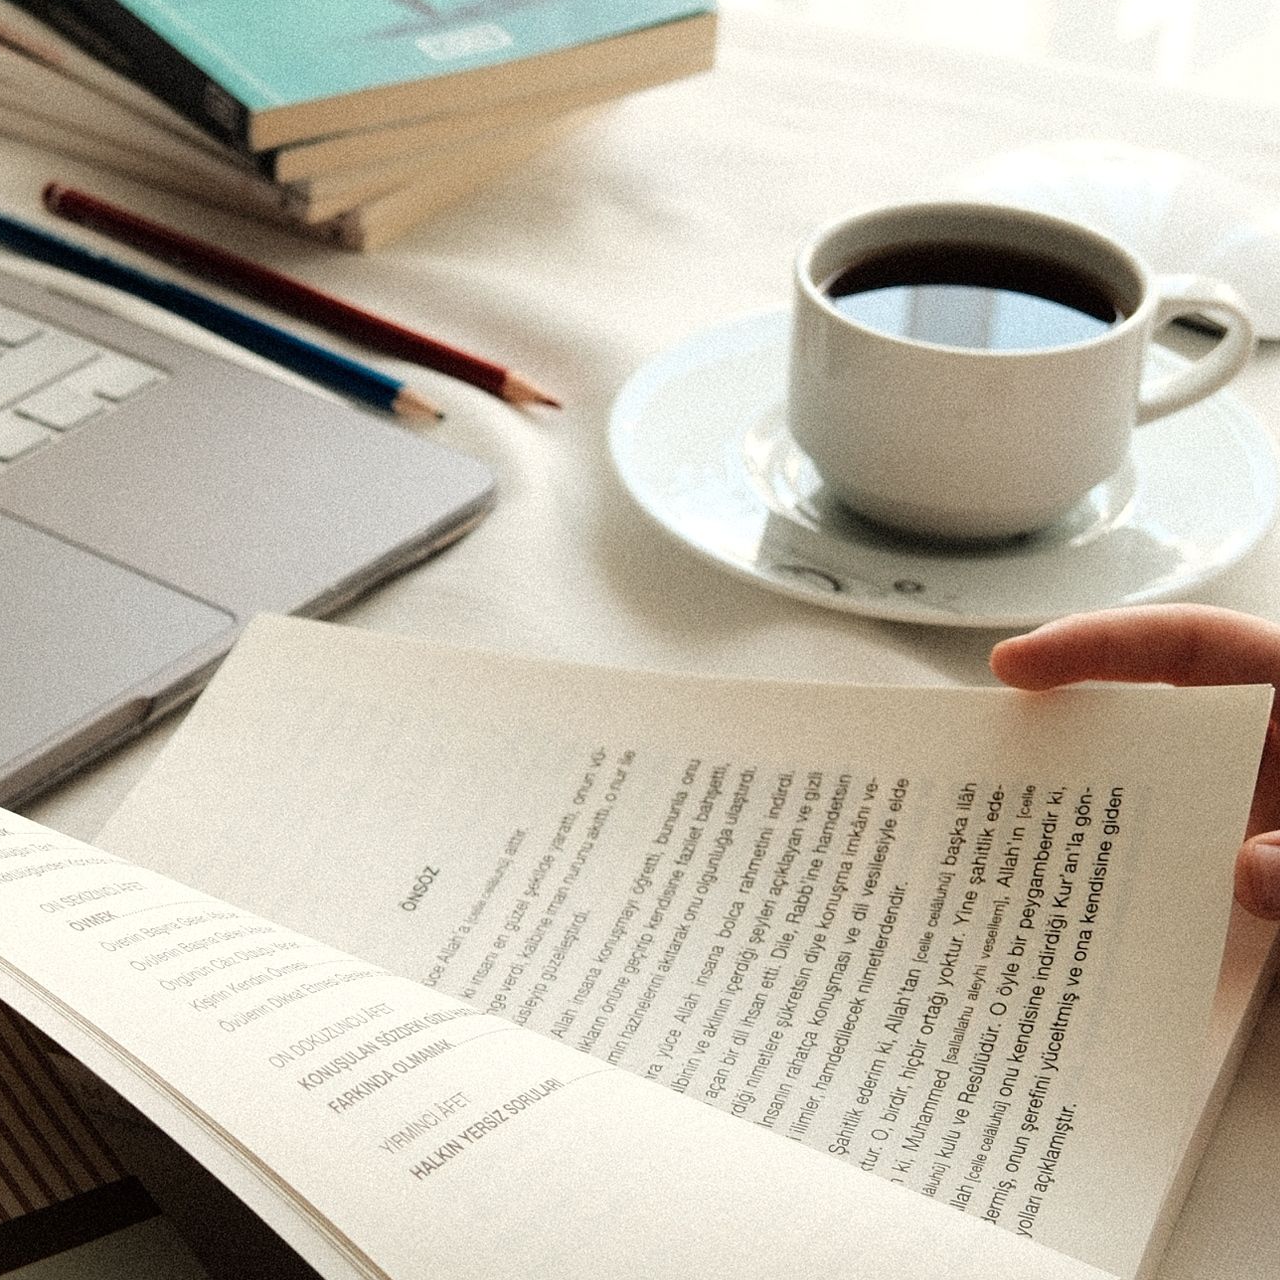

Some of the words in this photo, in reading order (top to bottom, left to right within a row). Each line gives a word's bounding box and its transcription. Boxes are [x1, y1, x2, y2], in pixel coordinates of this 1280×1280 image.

[803, 770, 823, 802] gizli
[888, 777, 910, 813] elde
[956, 781, 977, 811] ilâh
[985, 784, 1006, 823] ede-
[1015, 783, 1037, 819] [celle
[1045, 786, 1067, 806] ki,
[1074, 786, 1093, 828] gön-
[796, 804, 813, 824] ve
[812, 773, 851, 854] hamdetsin
[1102, 786, 1124, 836] giden
[769, 826, 804, 897] açıklayan
[862, 817, 898, 897] vesilesiyle
[941, 816, 969, 867] başka
[969, 827, 995, 885] şahitlik
[995, 826, 1026, 888] Allah'ın
[400, 863, 440, 913] ÖNSÖZ
[470, 951, 499, 986] insanı
[492, 933, 509, 950] en
[503, 898, 530, 933] güzel
[523, 854, 556, 898] şekilde
[572, 772, 596, 806] onun
[501, 962, 529, 992] verdi,
[521, 916, 554, 959] kalbine
[603, 791, 619, 804] o
[599, 975, 631, 1014] önüne
[623, 932, 655, 975] geçirip
[647, 868, 686, 930] kendisine
[674, 825, 704, 866] fazilet
[694, 763, 731, 823] bahşetti,
[785, 857, 824, 925] Rabb'ine
[1018, 811, 1058, 930] peygamberdir
[1051, 831, 1085, 909] Kur'an'la
[1079, 840, 1113, 925] kendisine
[38, 901, 65, 914] ON
[68, 910, 116, 932] ÖVMEK
[549, 1008, 577, 1040] Allah
[572, 966, 603, 1005] insana
[596, 898, 640, 964] konuşmayı
[631, 851, 665, 895] öğretti,
[653, 790, 690, 846] bununla
[680, 758, 703, 786] onu
[619, 973, 666, 1039] hazinelerini
[657, 923, 691, 973] akıtarak
[682, 895, 705, 922] onu
[696, 827, 734, 895] olgunluğa
[726, 767, 757, 825] ulaştırdı.
[659, 1028, 683, 1060] yüce
[673, 991, 701, 1025] Allah
[695, 944, 726, 987] insana
[715, 900, 746, 939] bolca
[738, 826, 774, 894] rahmetini
[768, 771, 795, 820] indirdi.
[748, 898, 777, 944] şeyleri
[851, 902, 870, 923] dil
[952, 889, 979, 926] Yine
[98, 932, 145, 953] Övenin
[138, 921, 182, 939] Başına
[128, 947, 182, 973] Övülenin
[176, 936, 221, 954] Başına
[745, 1029, 785, 1088] nimetlere
[776, 966, 813, 1028] şükretsin
[803, 932, 828, 964] diye
[816, 860, 854, 930] konuşma
[845, 805, 871, 857] imkânı
[862, 776, 880, 802] ve-
[769, 929, 799, 960] Dile,
[843, 926, 862, 945] ve
[912, 930, 935, 964] [celle
[1006, 934, 1028, 958] bir
[1036, 913, 1069, 981] indirdiği
[1072, 928, 1094, 963] ona
[725, 946, 759, 995] içerdiği
[760, 965, 782, 990] etti.
[937, 935, 964, 987] yoktur.
[966, 964, 988, 1002] aleyhi
[996, 961, 1021, 997] öyle
[1066, 965, 1084, 987] ve
[189, 989, 228, 1012] Kişinin
[226, 973, 273, 994] Kendini
[264, 961, 309, 979] Övmesi
[217, 1003, 268, 1034] Övülenin
[266, 988, 307, 1009] Dikkat
[299, 977, 341, 995] Etmesi
[740, 991, 768, 1028] ihsan
[791, 1094, 825, 1135] ilimler,
[814, 996, 867, 1090] hamdedilecek
[858, 882, 908, 994] nimetlerdendir.
[809, 950, 852, 1027] konuşması
[884, 967, 922, 1034] Allah'tan
[988, 1000, 1009, 1017] O
[267, 1051, 296, 1070] ON
[288, 1016, 369, 1057] DOKUZUNCU
[359, 1001, 395, 1021] ÂFET
[702, 997, 732, 1039] aklının
[919, 990, 950, 1036] ortağı
[1007, 984, 1046, 1064] kendisine
[1041, 991, 1081, 1071] yüceltmiş
[297, 1043, 380, 1091] KONUŞULAN
[374, 1019, 429, 1047] SÖZDEKİ
[422, 1011, 456, 1026] GİZLİ
[693, 1039, 712, 1055] ve
[719, 1047, 740, 1067] bir
[731, 1028, 750, 1047] dil
[785, 1030, 819, 1079] rahatça
[874, 1038, 898, 1056] ki,
[898, 1037, 928, 1080] hiçbir
[327, 1069, 395, 1114] FARKINDA
[391, 1039, 453, 1075] OLMAMAK
[704, 1067, 730, 1100] açan
[855, 1057, 887, 1106] ederim
[957, 1023, 1002, 1104] Resûlüdür.
[998, 1066, 1021, 1098] onu
[378, 1112, 441, 1155] YİRMİNCİ
[433, 1090, 468, 1119] ÂFET
[754, 1082, 793, 1129] İnsanın
[879, 1084, 913, 1123] birdir,
[901, 1067, 952, 1151] Muhammed
[952, 1107, 971, 1126] ve
[1020, 1074, 1051, 1132] şerefini
[409, 1140, 464, 1181] HALKIN
[457, 1108, 509, 1144] YERSİZ
[502, 1078, 563, 1116] SORULARI
[827, 1108, 864, 1156] Şahitlik
[869, 1126, 895, 1142] O,
[934, 1129, 962, 1160] kulu
[891, 1158, 916, 1174] ki,
[1004, 1135, 1031, 1174] onun
[1017, 1194, 1043, 1239] yolları
[1033, 1103, 1077, 1193] açıklamıştır.
